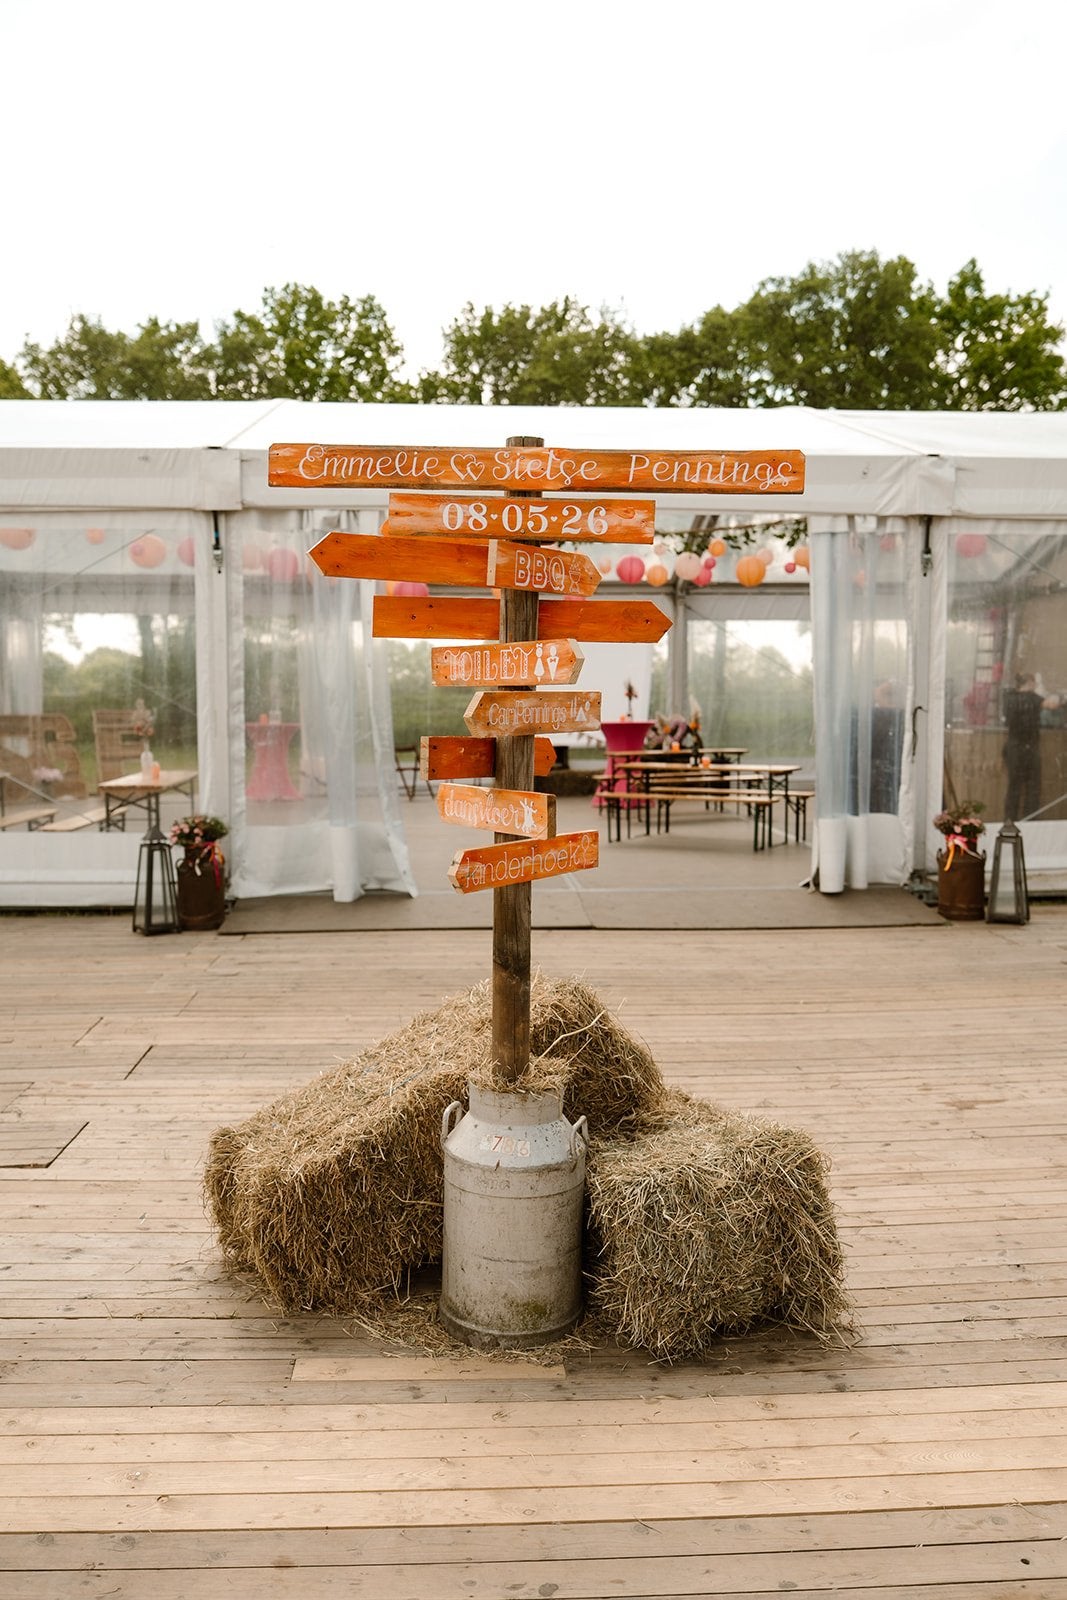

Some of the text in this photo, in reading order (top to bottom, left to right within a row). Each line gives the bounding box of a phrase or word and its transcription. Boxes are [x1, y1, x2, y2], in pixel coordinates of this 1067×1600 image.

[299, 445, 793, 490] Emmelie Sietse Pennings
[515, 550, 565, 591] BBQ
[444, 646, 534, 681] TOILET
